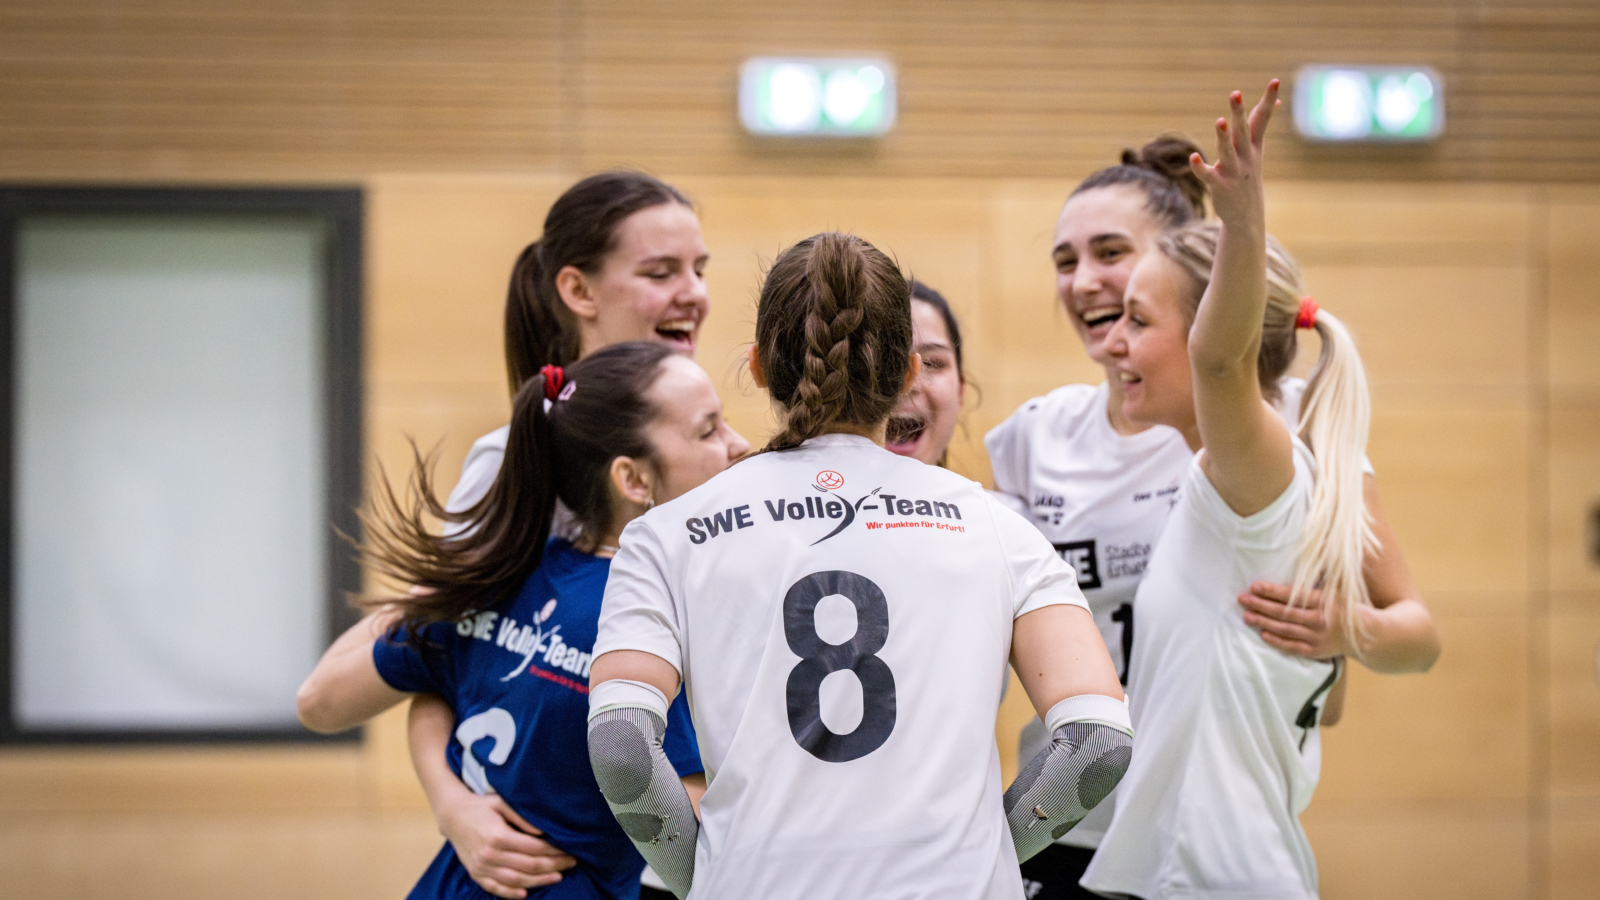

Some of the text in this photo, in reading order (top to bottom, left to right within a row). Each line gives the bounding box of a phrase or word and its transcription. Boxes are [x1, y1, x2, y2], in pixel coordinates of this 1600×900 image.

[685, 504, 754, 545] SWE
[865, 520, 965, 533] Wir punkten für Erfurt!
[783, 569, 897, 763] 8
